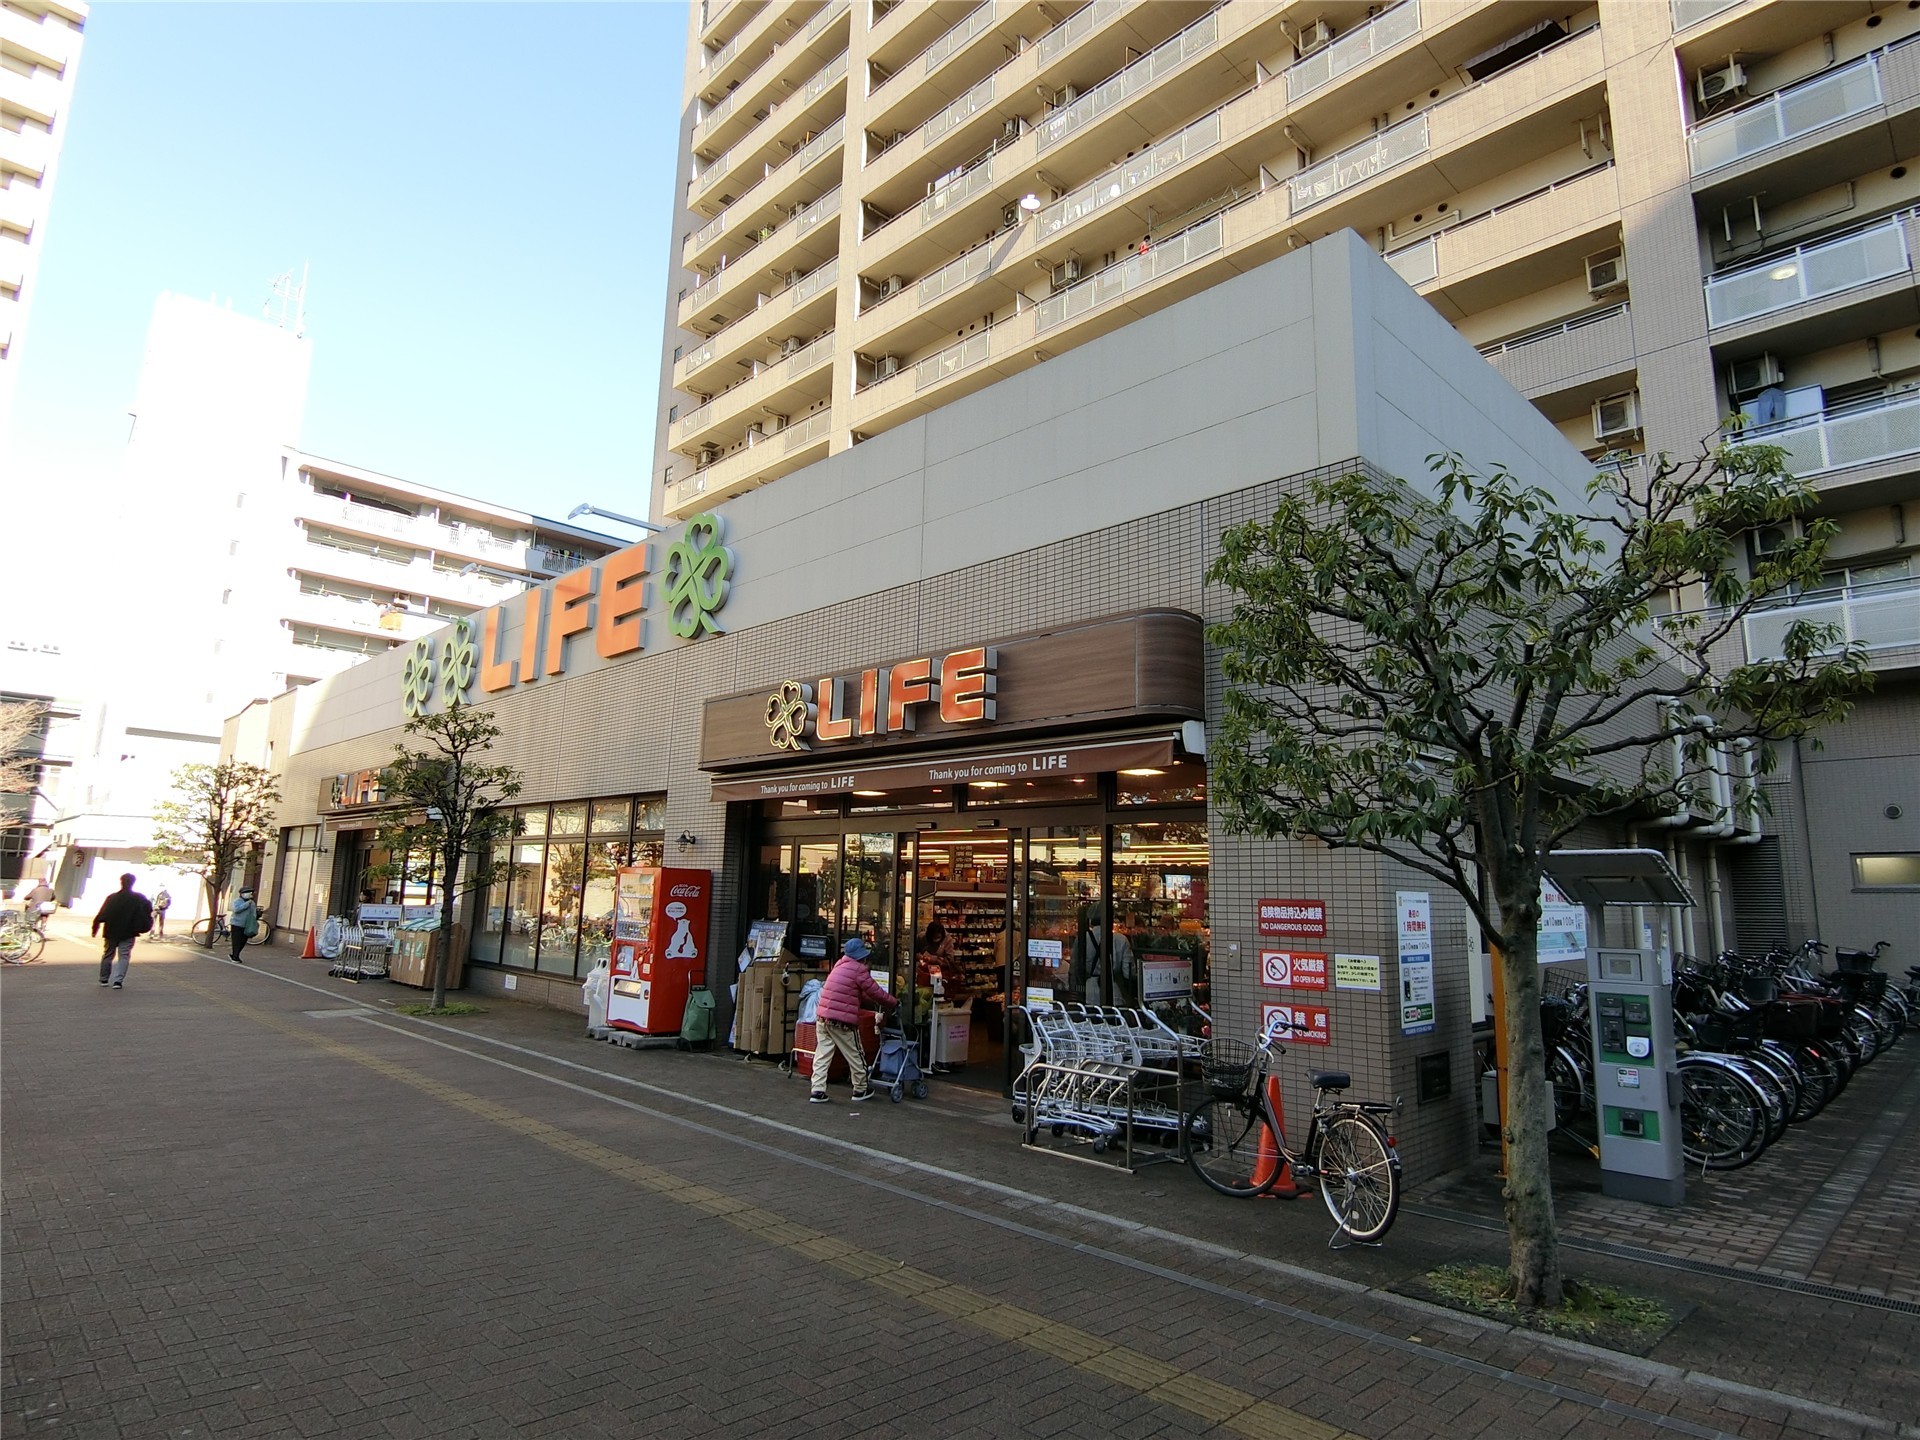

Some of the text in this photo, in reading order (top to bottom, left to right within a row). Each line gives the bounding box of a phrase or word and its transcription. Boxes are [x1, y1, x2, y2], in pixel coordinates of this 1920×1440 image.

[481, 543, 650, 693] LIFE
[817, 646, 990, 741] LIFE
[929, 755, 1067, 781] Thank you for coming to LIFE
[761, 776, 855, 795] Thank you for coming to LIFE
[1261, 906, 1323, 920] 危険物品持込み厳禁
[1261, 922, 1323, 932] NO DANGEROUS GOODS
[1293, 958, 1325, 972] 火気厳禁
[1293, 975, 1325, 985] NO OPEN FLAME
[1303, 1030, 1327, 1039] SMOKING
